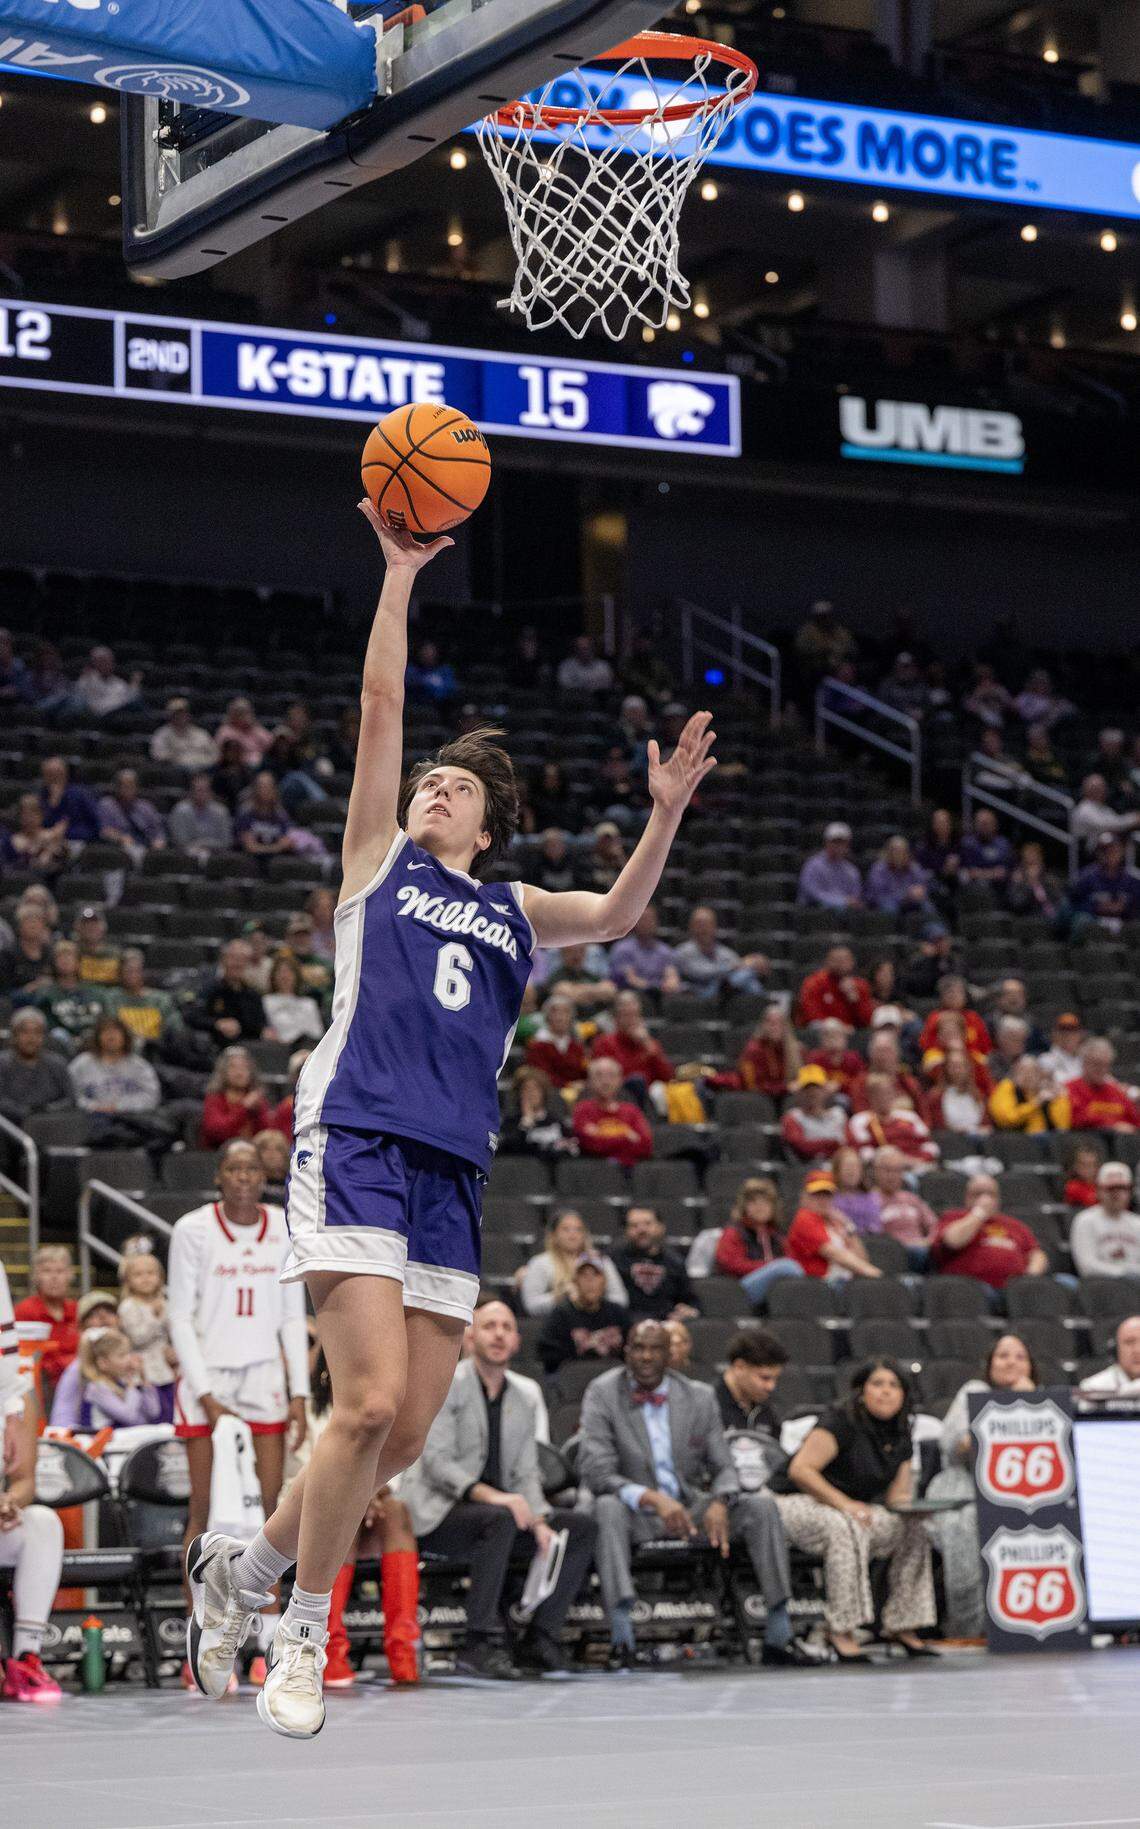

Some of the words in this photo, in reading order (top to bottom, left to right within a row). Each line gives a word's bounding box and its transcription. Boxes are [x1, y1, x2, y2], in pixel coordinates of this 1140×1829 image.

[857, 121, 1018, 189] MORE
[127, 336, 190, 374] 2ND
[237, 342, 446, 406] K-STATE
[518, 365, 589, 431] 15
[838, 394, 1025, 459] UMB
[433, 941, 474, 1012] 6
[235, 1286, 255, 1318] 11
[988, 1418, 1056, 1437] PHILLIPS
[995, 1445, 1055, 1489] 66
[1000, 1543, 1067, 1562] PHILLIPS
[1005, 1571, 1066, 1615] 66
